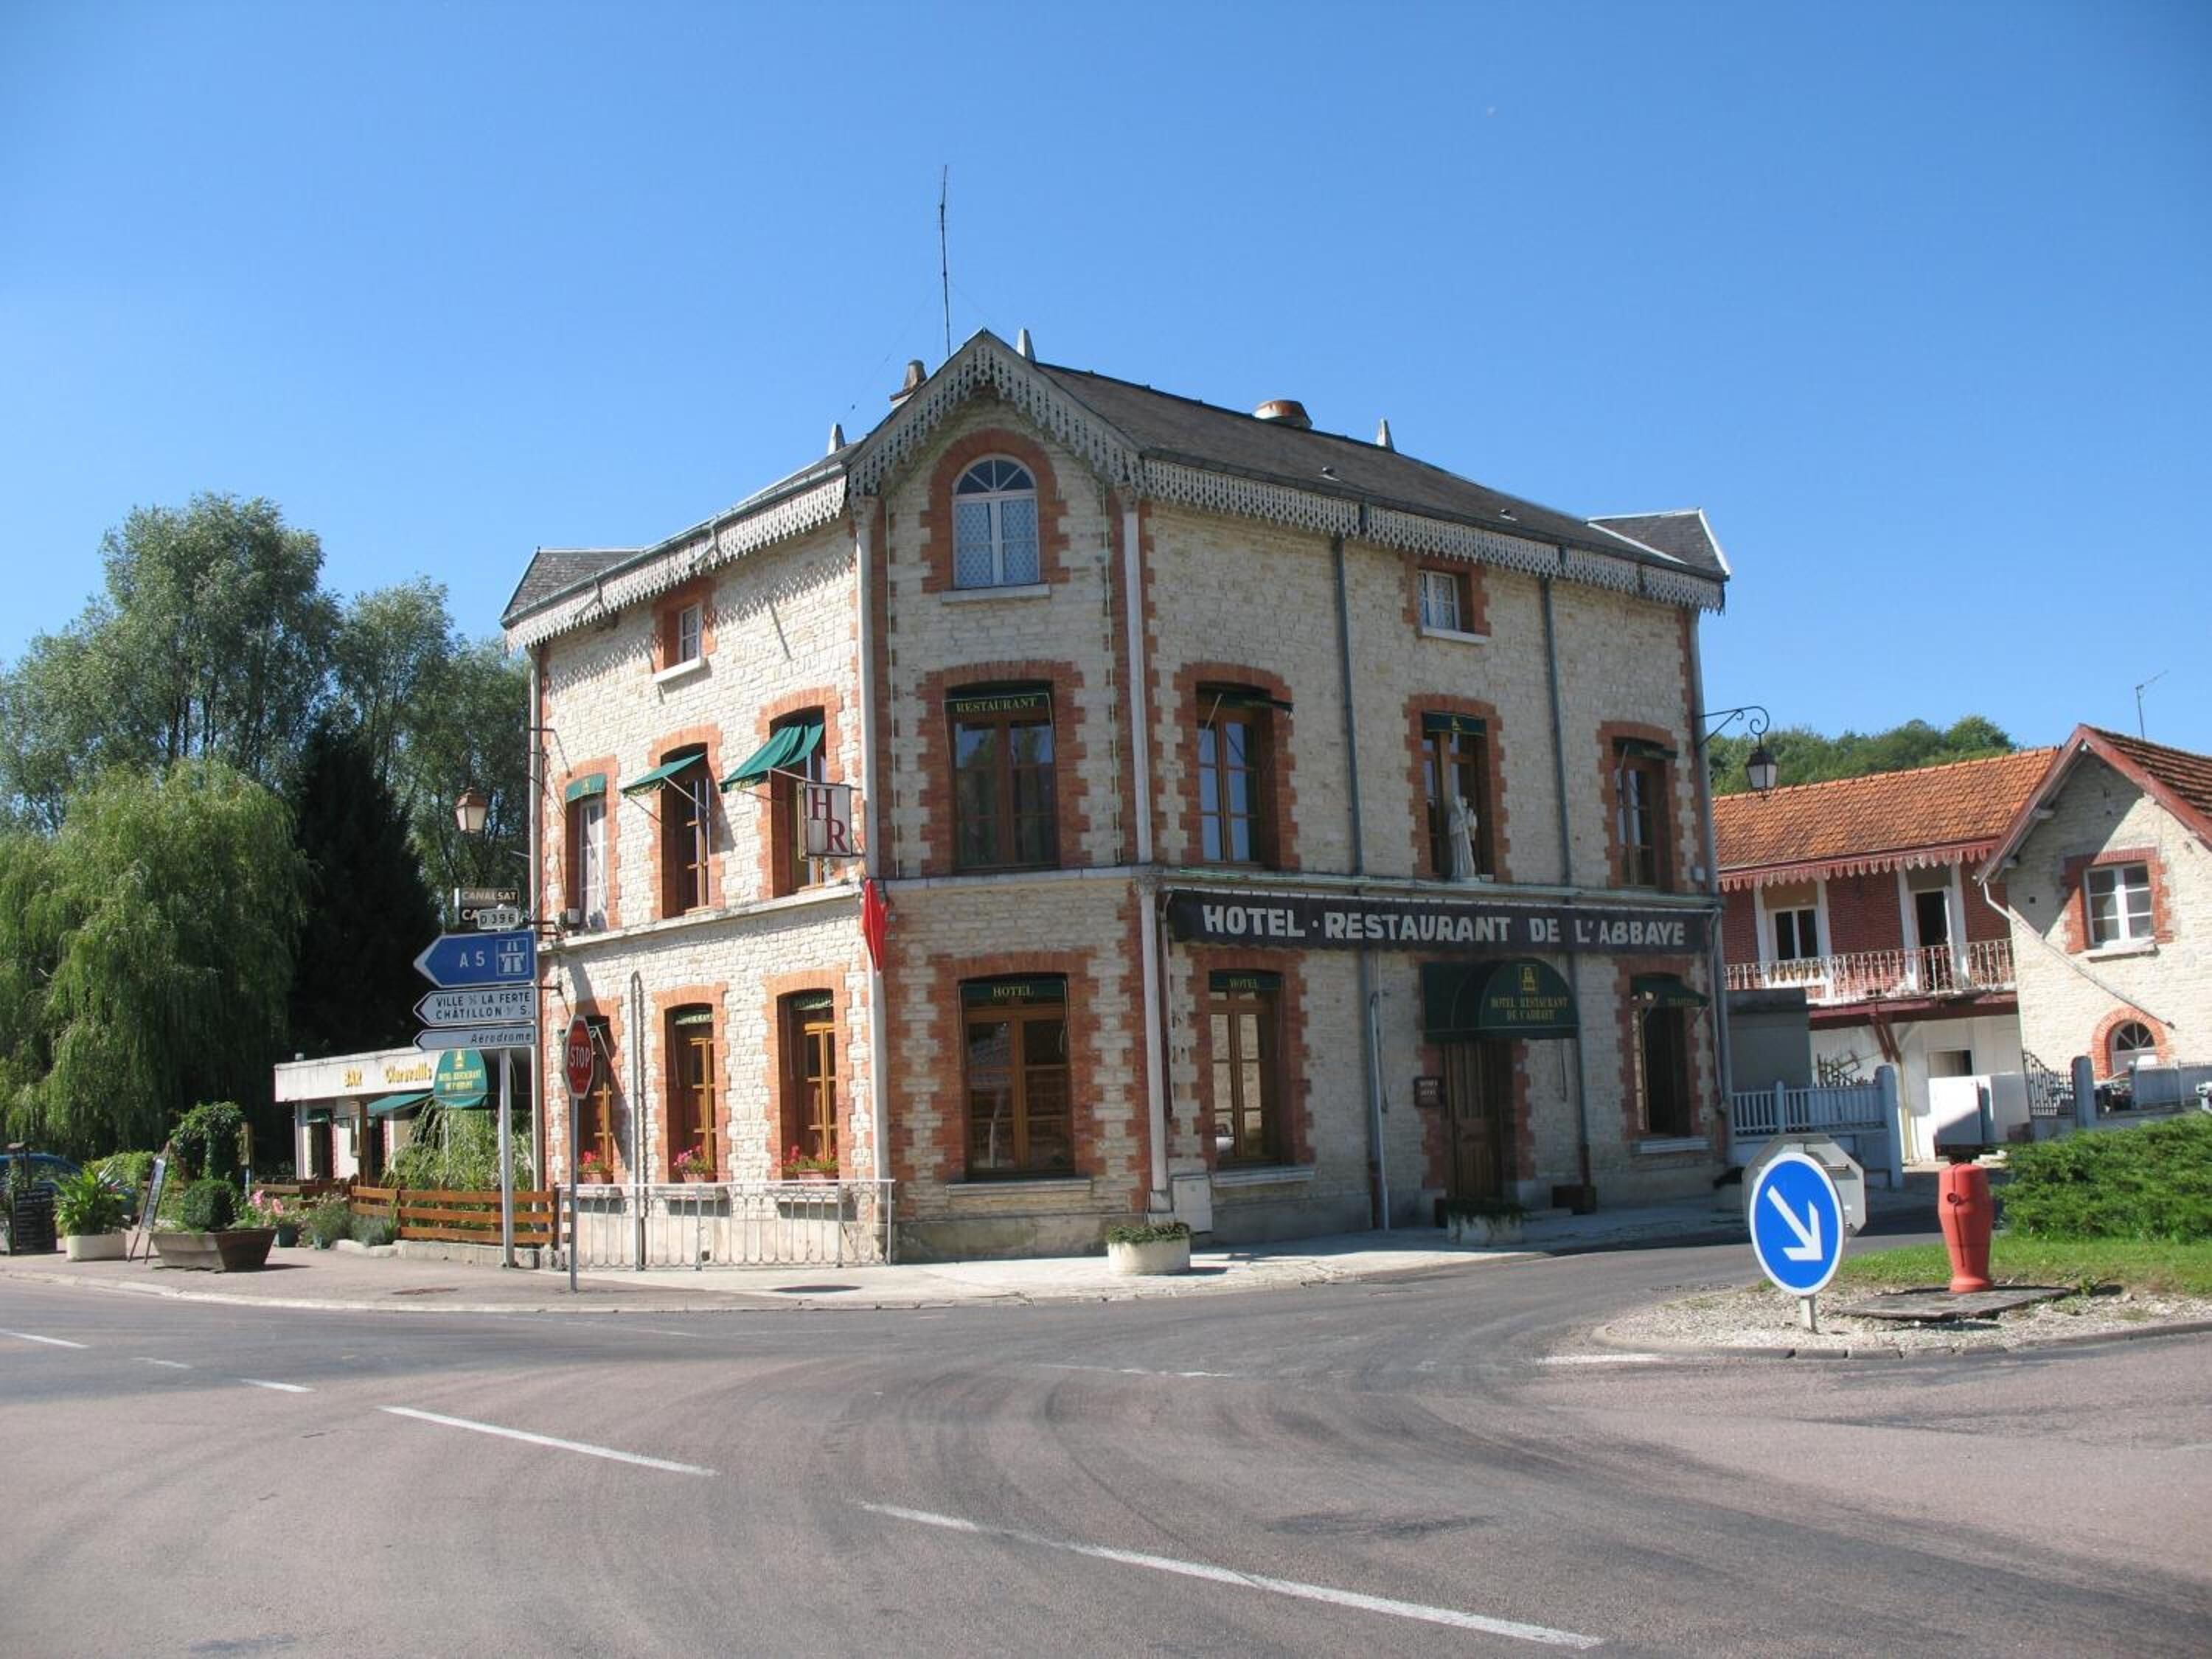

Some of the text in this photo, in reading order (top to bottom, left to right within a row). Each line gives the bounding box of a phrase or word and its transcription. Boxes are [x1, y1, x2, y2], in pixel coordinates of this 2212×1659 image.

[956, 697, 1037, 713] RESTAURANT
[462, 890, 516, 901] CANALSAT
[1202, 904, 1686, 947] HOTEL RESTAURANT DE L'ABBAYE
[459, 951, 485, 968] A 5
[992, 984, 1033, 998] HOTEL
[436, 995, 464, 1007] VILLE
[481, 995, 495, 1005] LA
[436, 1006, 502, 1020] CHÂTILLON
[471, 1031, 531, 1044] Aérodrome
[569, 1046, 591, 1068] STOP
